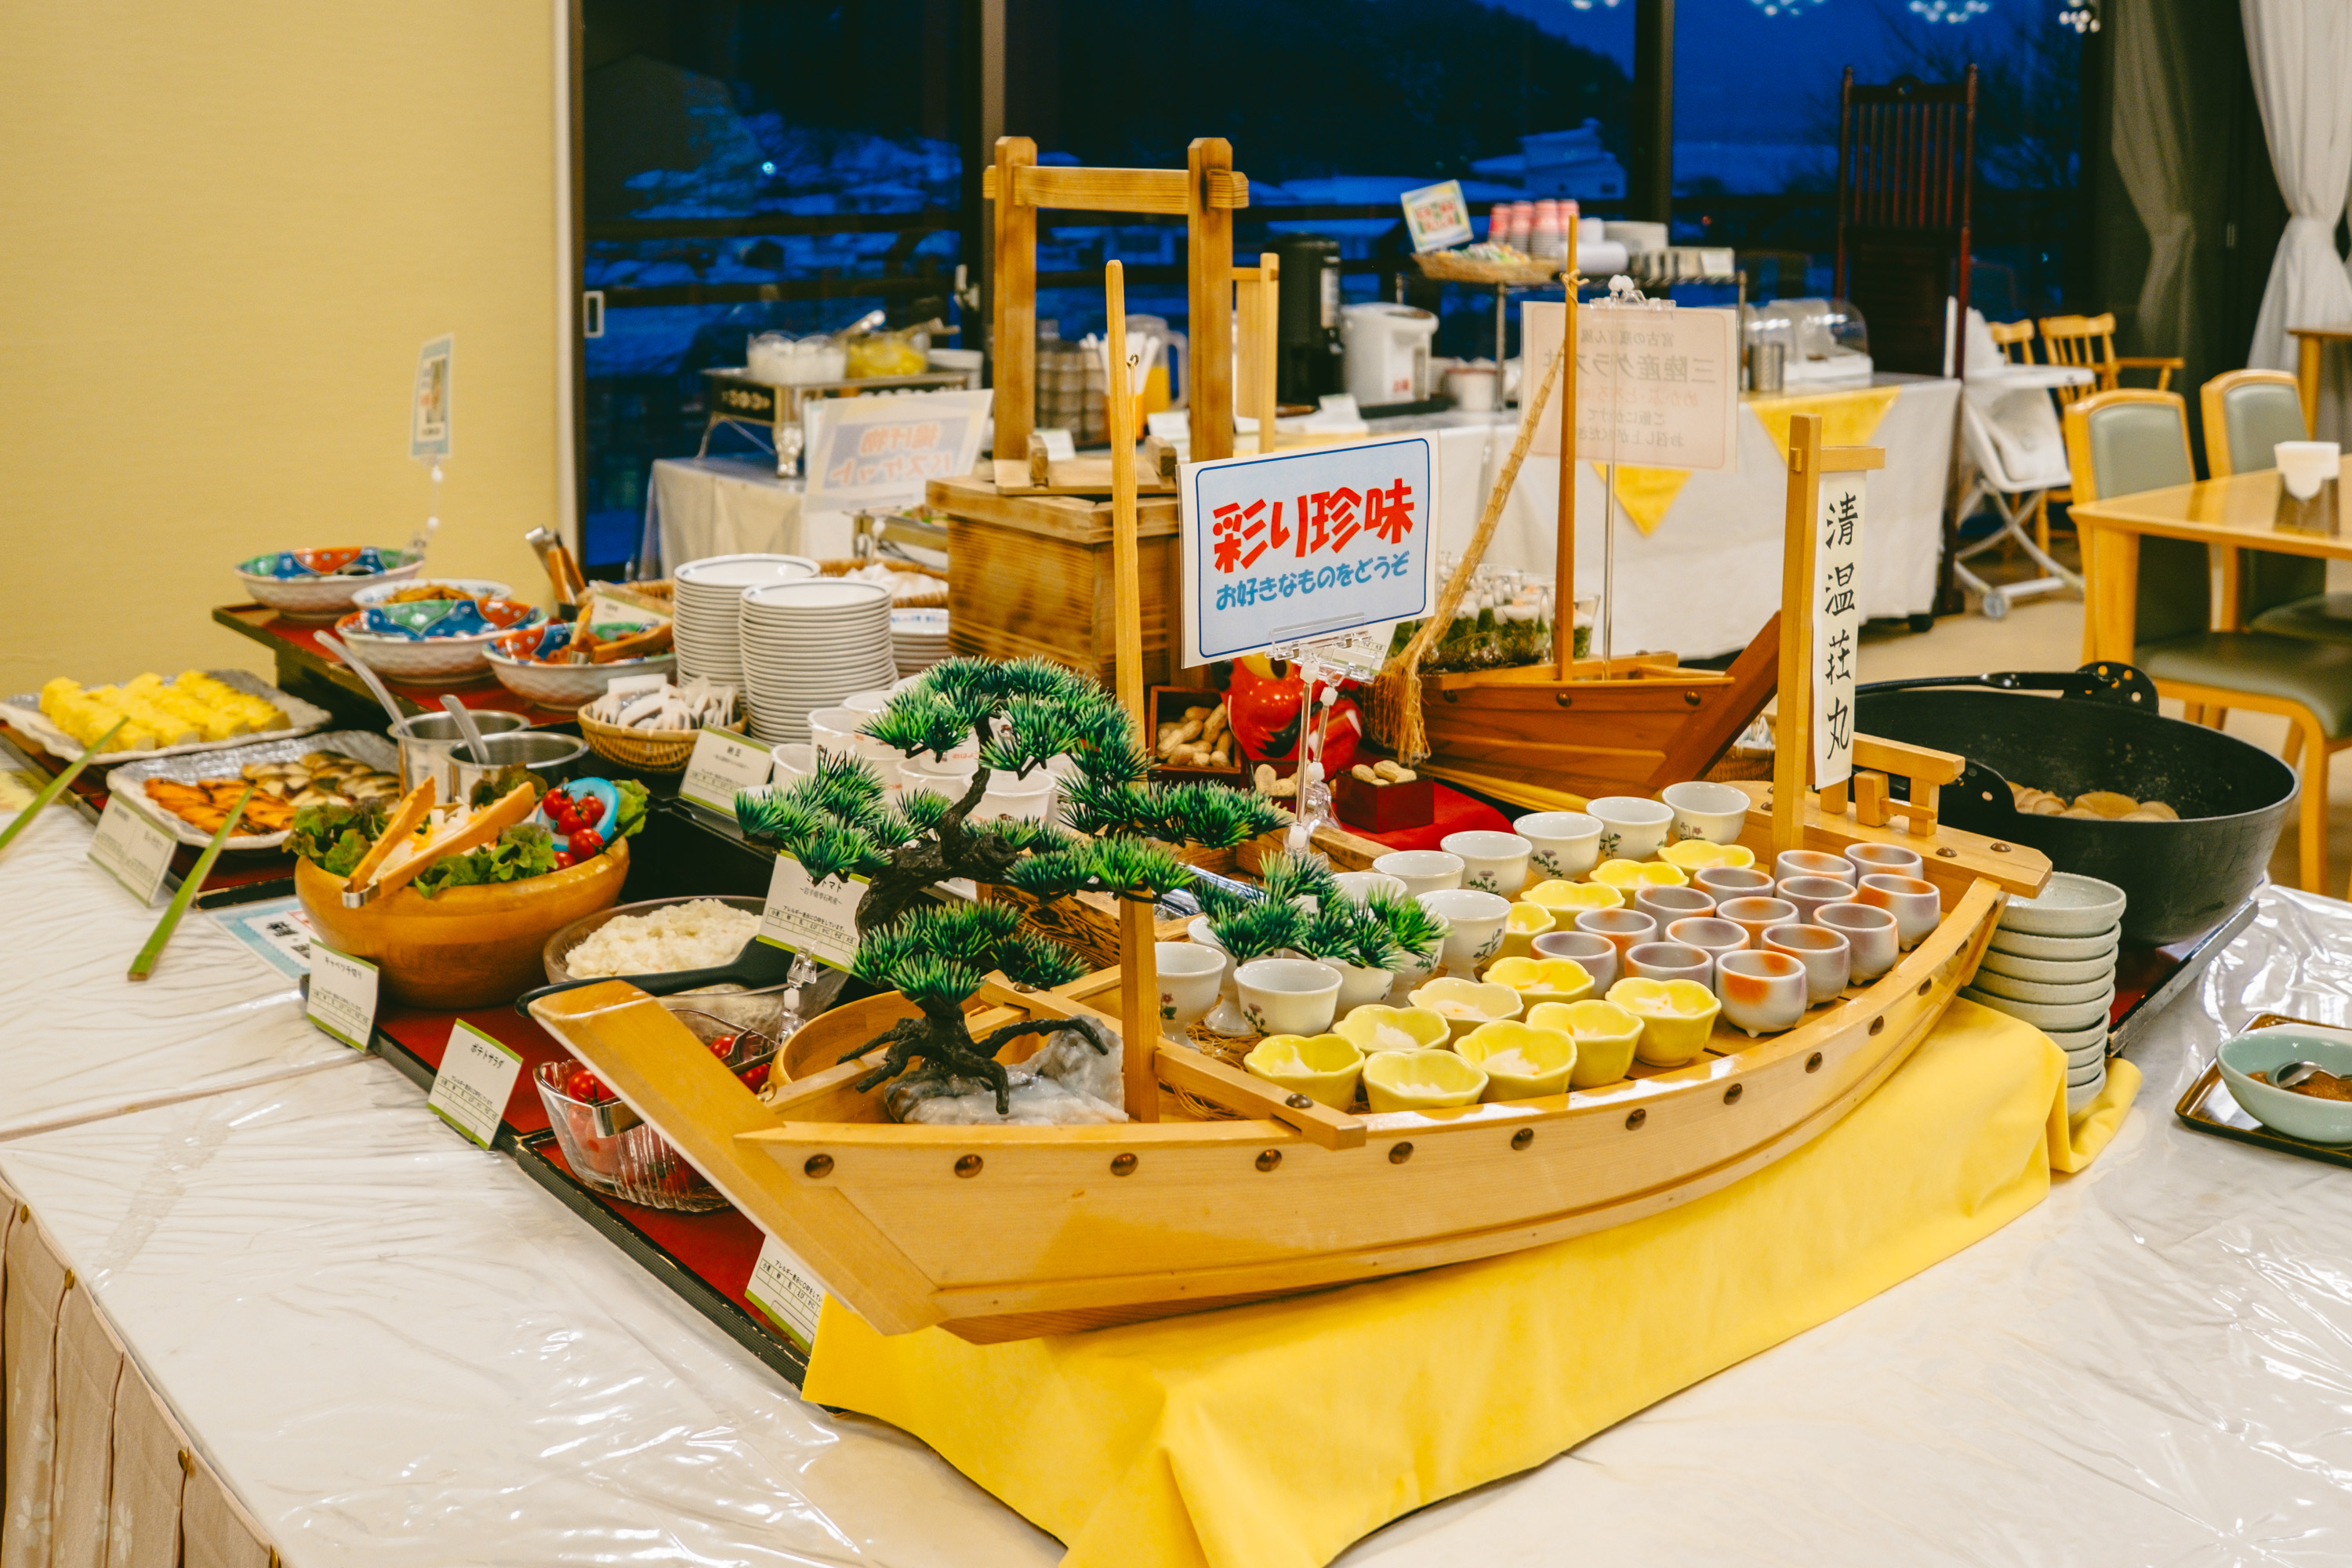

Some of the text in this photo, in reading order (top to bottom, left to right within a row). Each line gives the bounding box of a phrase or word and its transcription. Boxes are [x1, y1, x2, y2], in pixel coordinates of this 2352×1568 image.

[1213, 478, 1414, 573] 彩り珍味
[1216, 550, 1410, 611] お好きなものをどうぞ
[1825, 492, 1859, 760] 清温荘丸
[806, 874, 842, 893] ミトマト
[470, 1043, 505, 1069] ポテトサラダ
